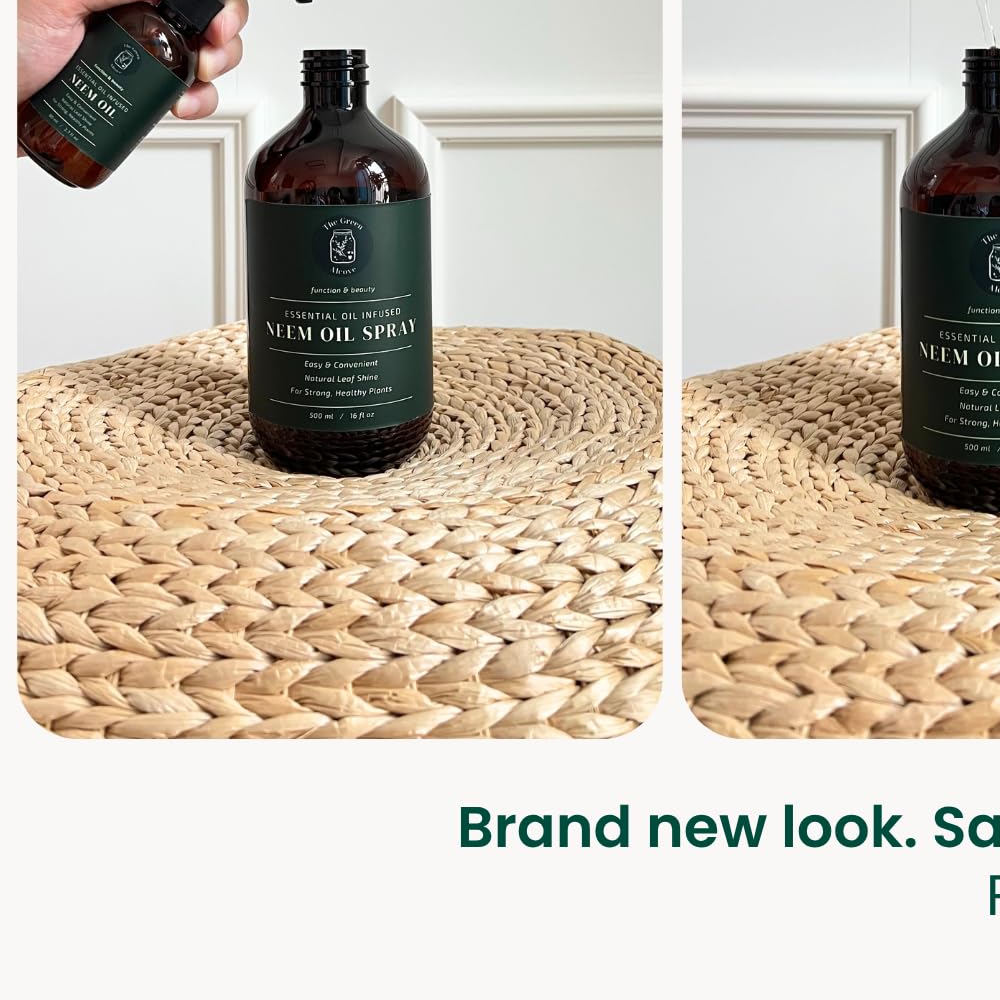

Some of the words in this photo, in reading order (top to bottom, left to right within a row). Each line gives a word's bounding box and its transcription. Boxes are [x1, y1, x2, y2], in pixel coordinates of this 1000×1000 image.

[69, 74, 98, 101] NEEM
[98, 100, 116, 118] OIL
[323, 217, 338, 231] The
[340, 217, 363, 230] Green
[981, 231, 998, 245] The
[311, 286, 341, 294] function
[351, 286, 375, 294] beauty
[285, 310, 337, 320] ESSENTIAL
[342, 312, 358, 320] OIL
[362, 308, 401, 319] INFUSED
[967, 306, 1000, 314] function
[266, 321, 312, 341] NEEM
[320, 327, 354, 342] OIL
[363, 318, 417, 341] SPRAY
[939, 331, 996, 343] ESSENTIAL
[919, 341, 968, 365] NEEM
[305, 361, 322, 369] Easy
[334, 360, 378, 368] Convenient
[337, 375, 355, 383] Leaf
[291, 387, 302, 395] For
[305, 389, 332, 398] Strong,
[336, 389, 367, 397] Healthy
[369, 386, 392, 394] Plants
[959, 387, 979, 397] Easy
[982, 388, 988, 396] &
[960, 403, 992, 412] Natural
[359, 412, 364, 420] fl
[945, 415, 957, 424] For
[960, 417, 990, 428] Strong,
[965, 443, 978, 451] 500
[981, 444, 991, 452] ml
